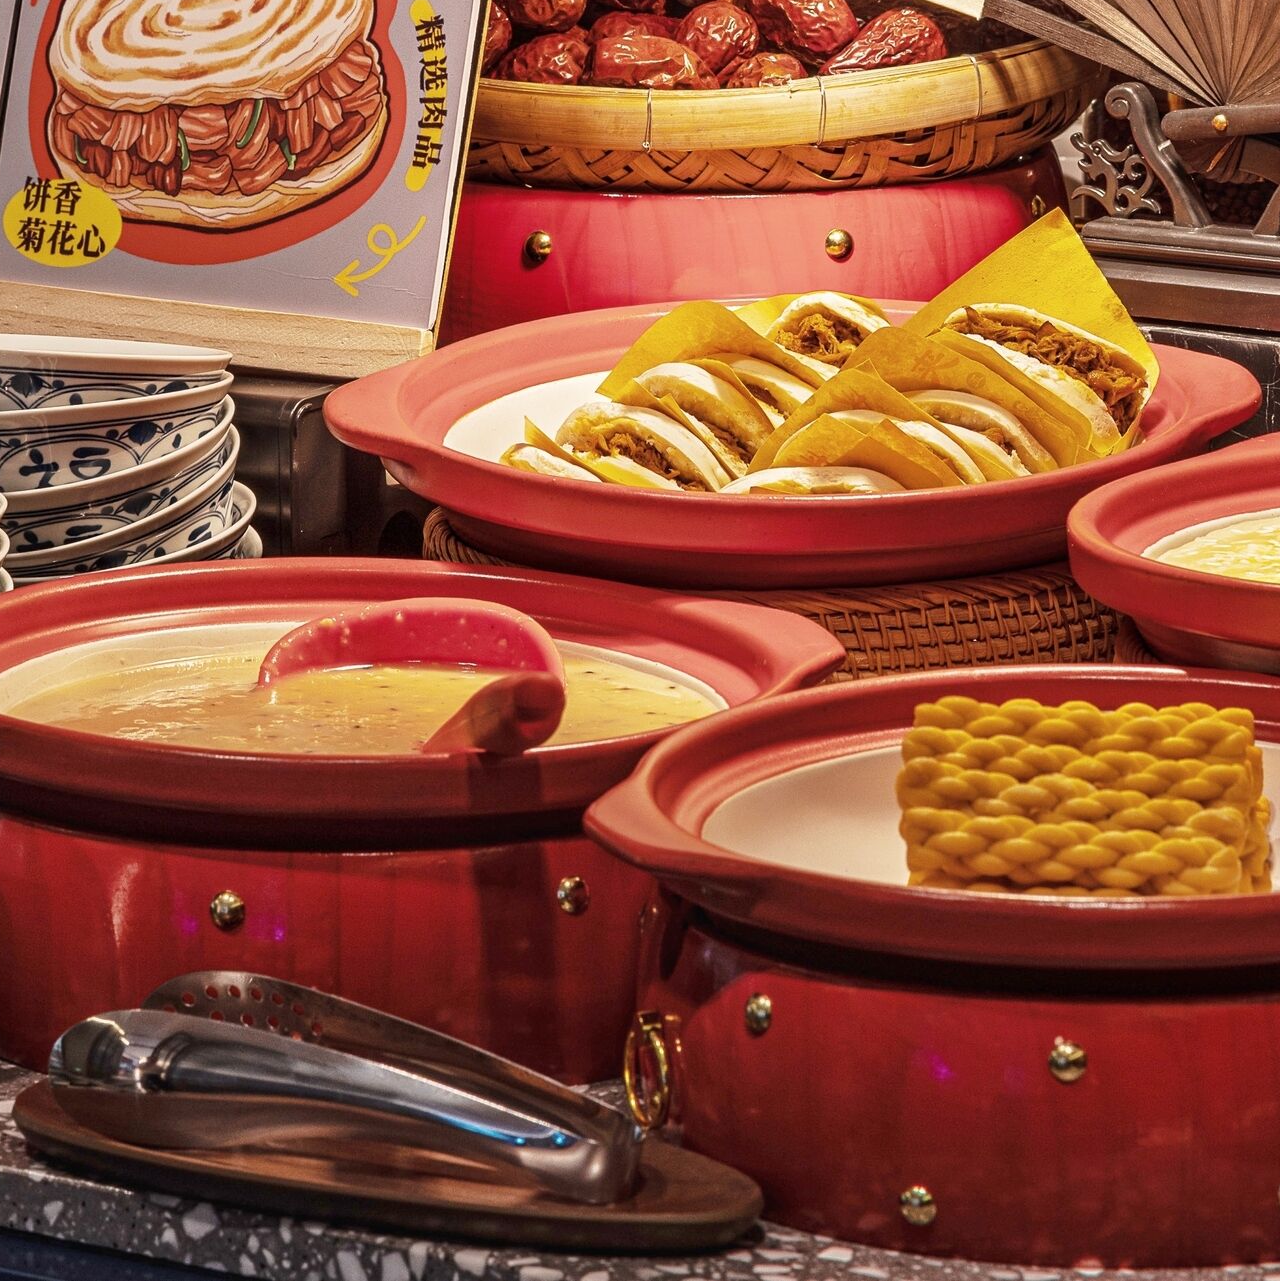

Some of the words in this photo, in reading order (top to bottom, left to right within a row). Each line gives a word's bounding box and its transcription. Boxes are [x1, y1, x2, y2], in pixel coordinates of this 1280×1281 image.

[412, 14, 448, 169] 精选肉品
[23, 176, 82, 216] 饼香
[16, 217, 106, 258] 菊花心
